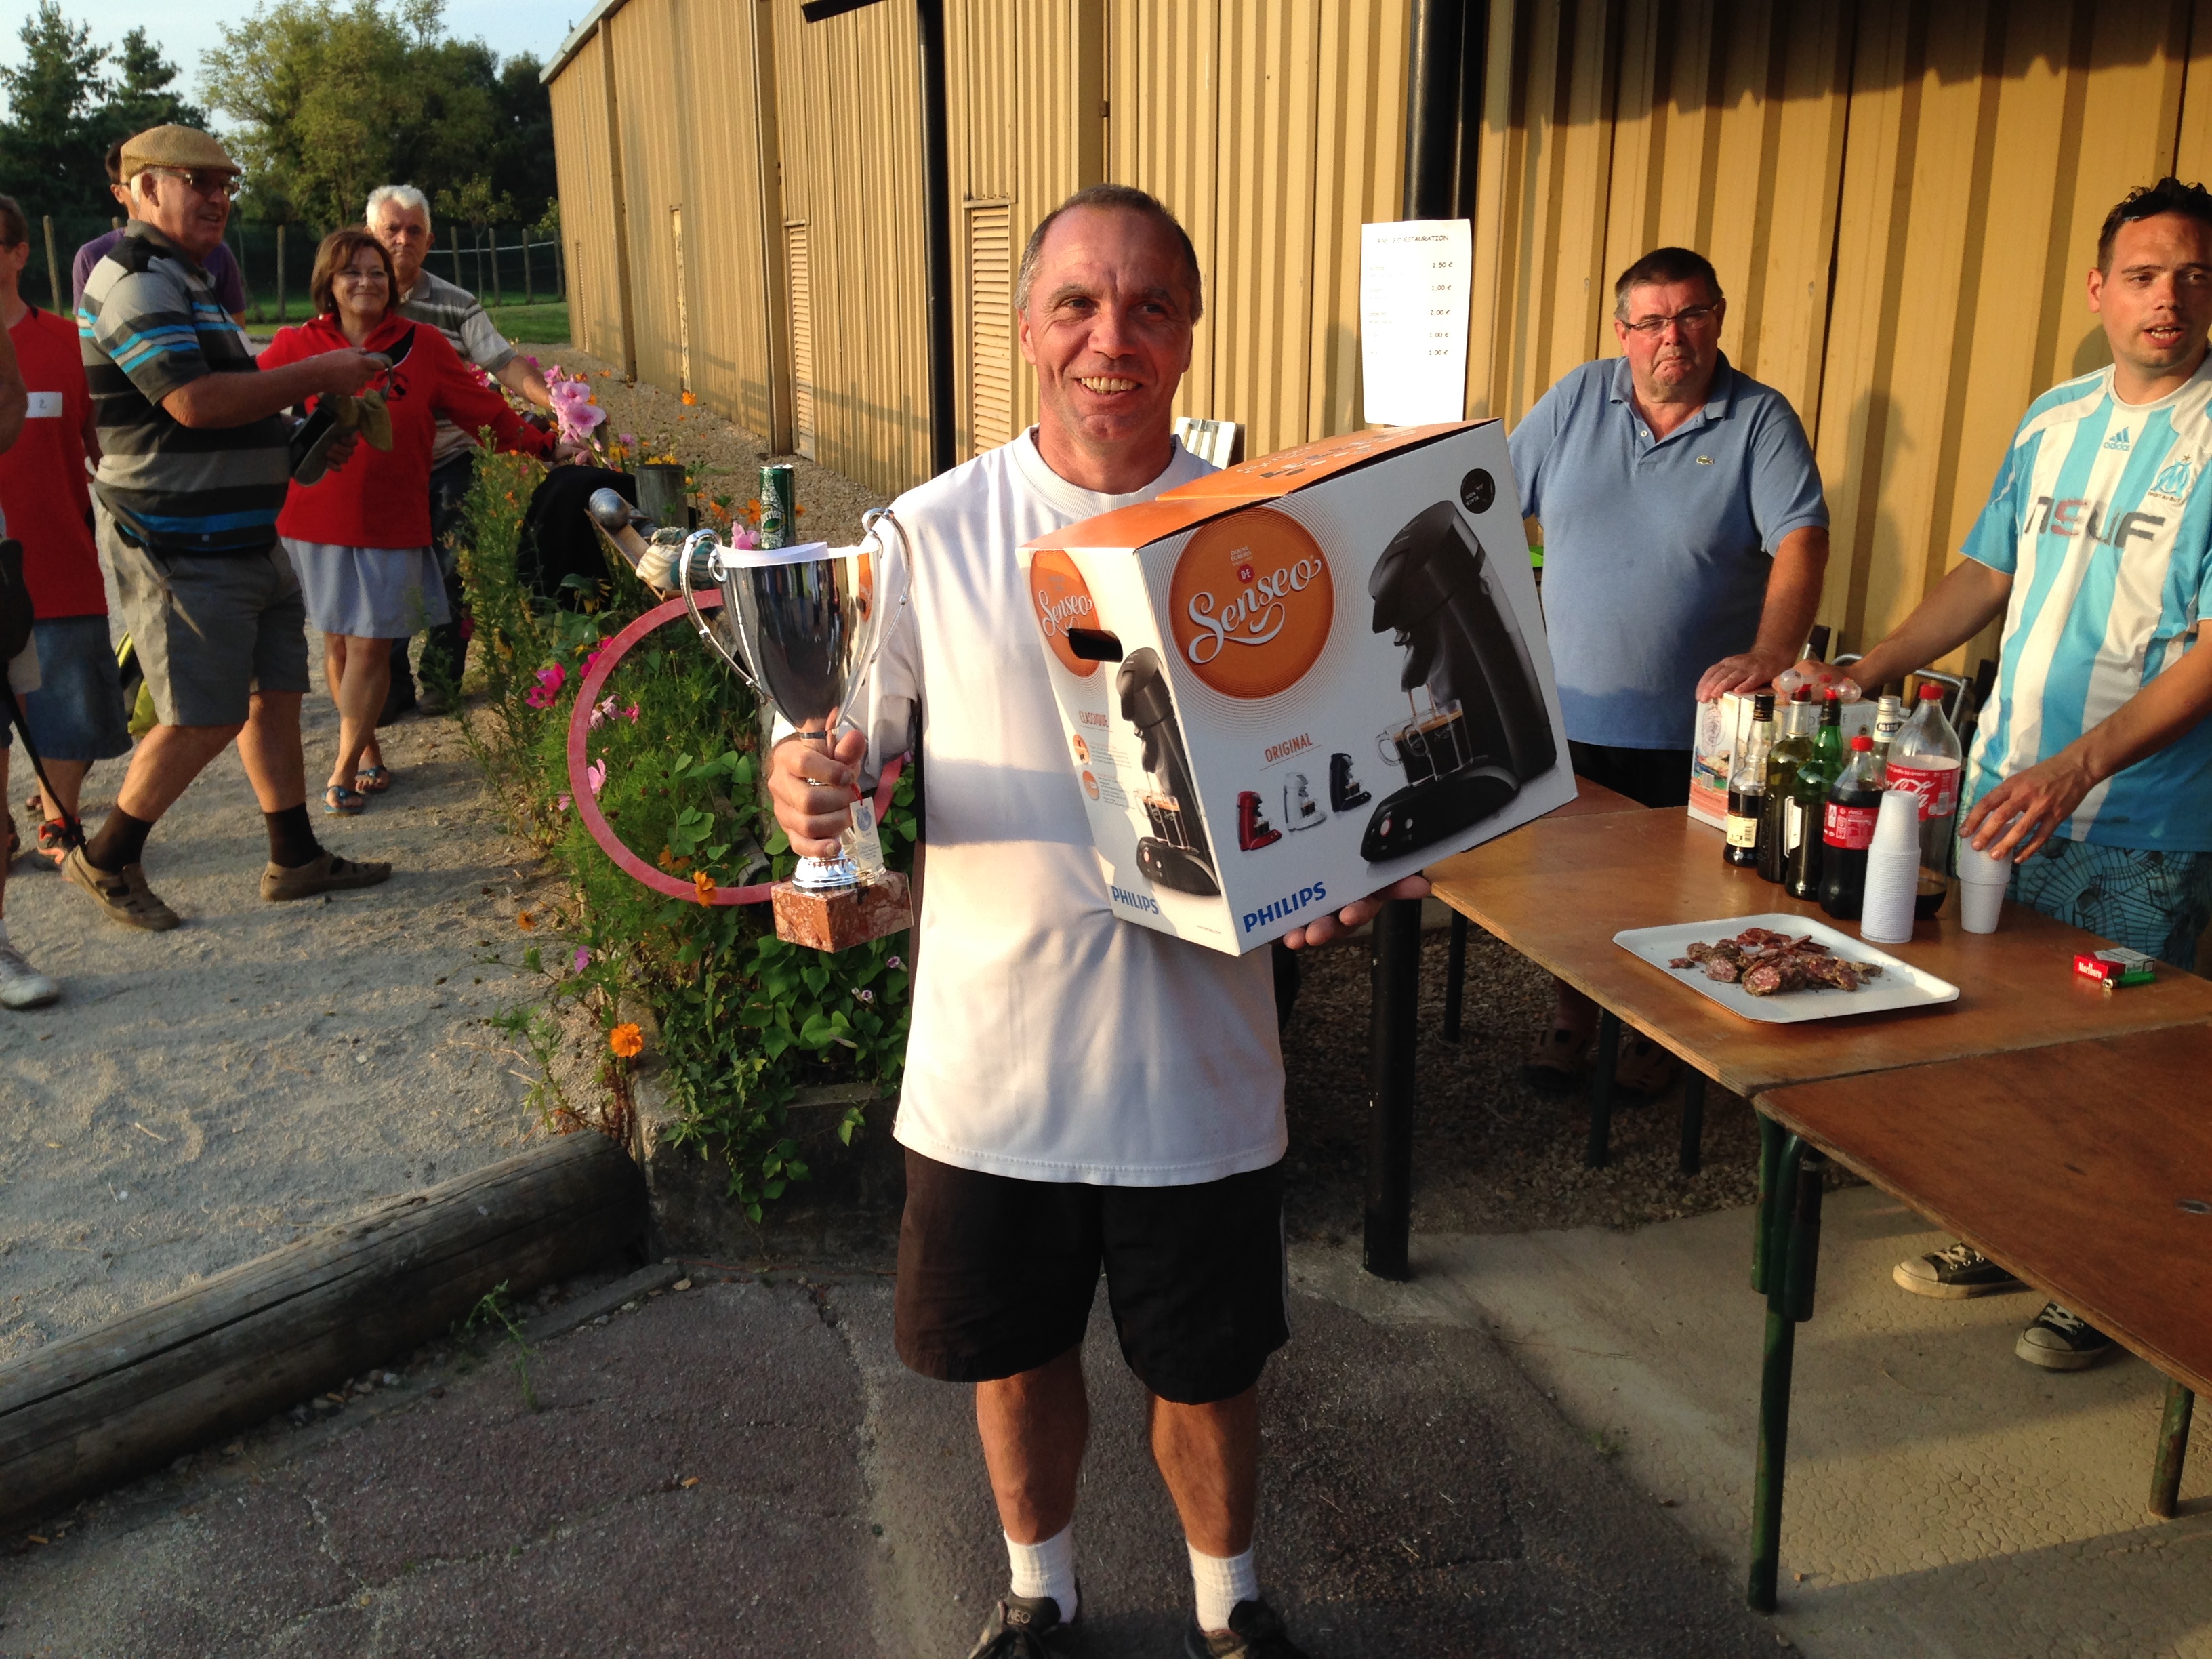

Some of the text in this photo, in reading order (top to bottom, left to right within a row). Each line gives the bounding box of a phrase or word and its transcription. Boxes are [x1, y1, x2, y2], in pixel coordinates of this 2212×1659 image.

[1038, 590, 1092, 638] Senseo
[1188, 558, 1322, 664] Senseo
[1265, 733, 1313, 762] ORIGINAL
[1111, 885, 1159, 915] PHILIPS
[1242, 881, 1326, 933] PHILIPS
[2078, 962, 2102, 979] Marlboro
